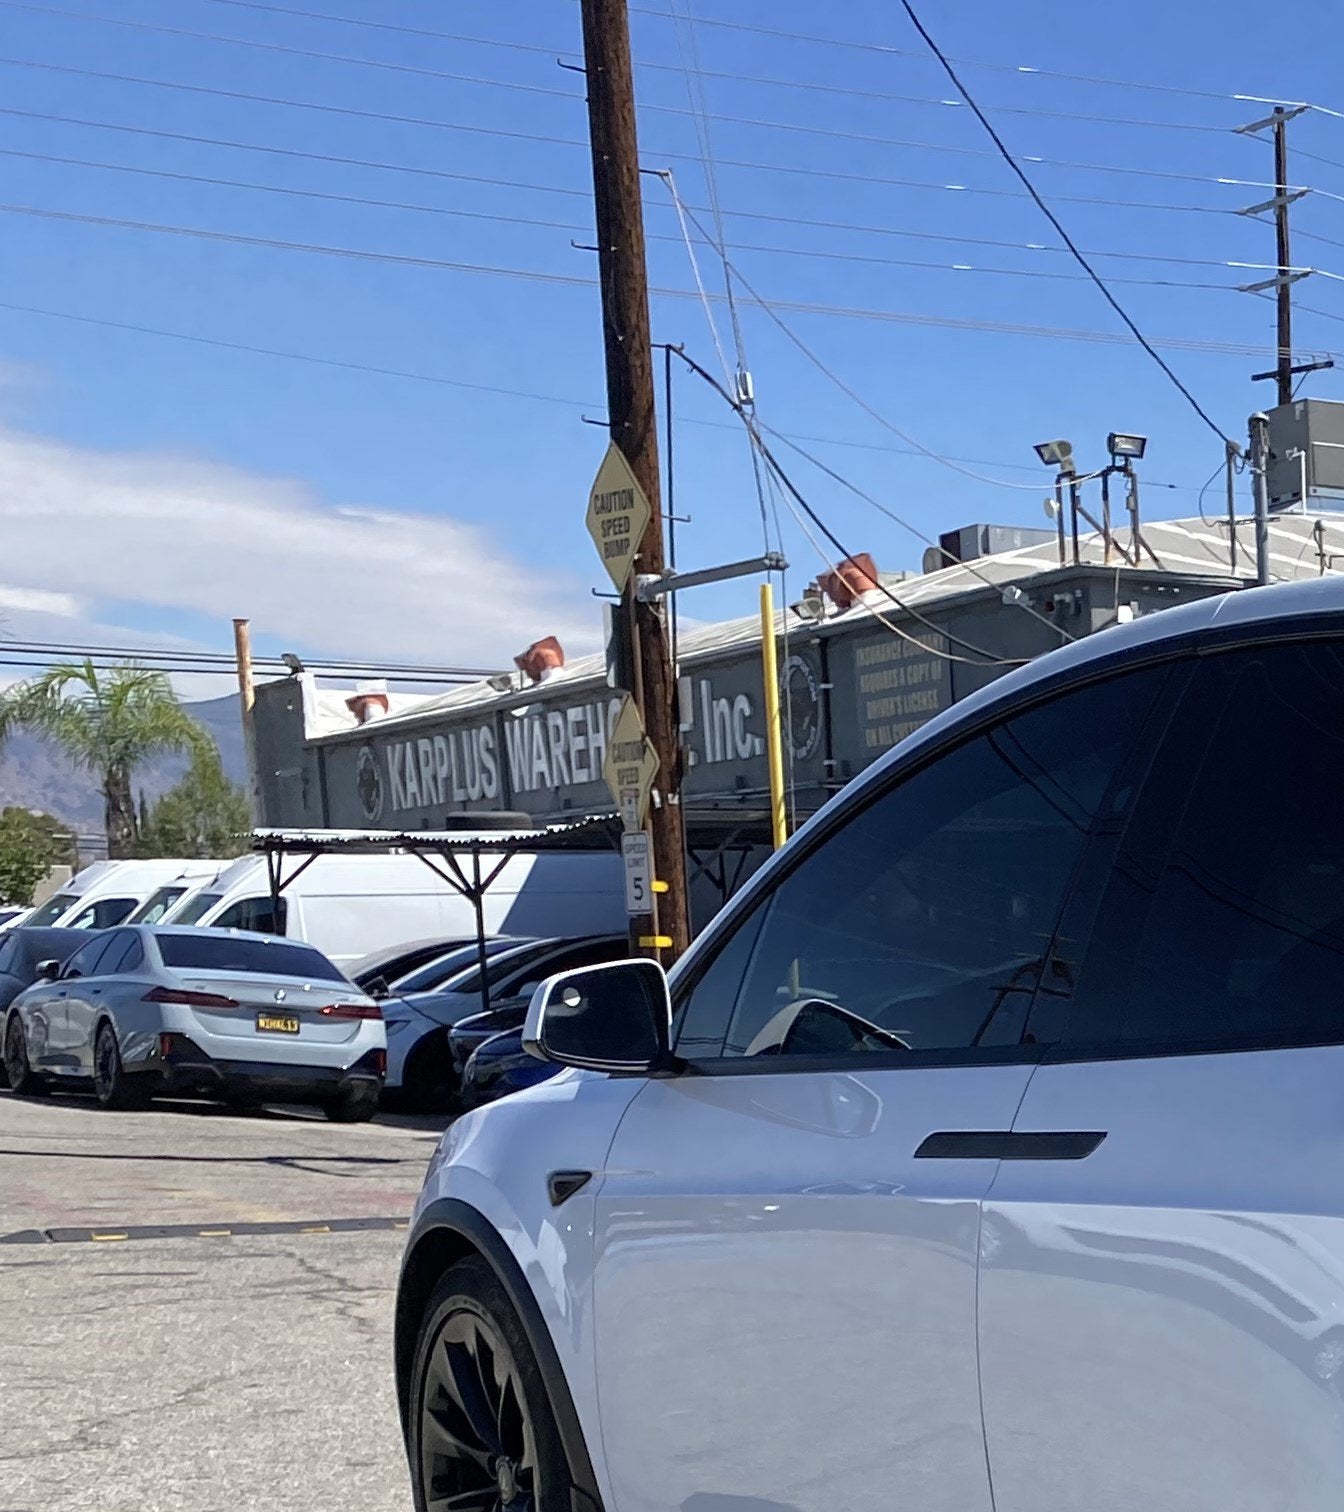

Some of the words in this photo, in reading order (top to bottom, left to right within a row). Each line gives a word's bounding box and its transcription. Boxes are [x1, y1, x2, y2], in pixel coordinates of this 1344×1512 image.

[594, 488, 634, 516] CAUTION
[601, 516, 631, 538] SPEED
[386, 725, 498, 810] KARPLUS
[700, 680, 764, 763] Inc.
[617, 767, 639, 786] SPEED
[624, 843, 647, 854] SPEED
[627, 857, 645, 868] LIMIT
[633, 877, 644, 901] 5
